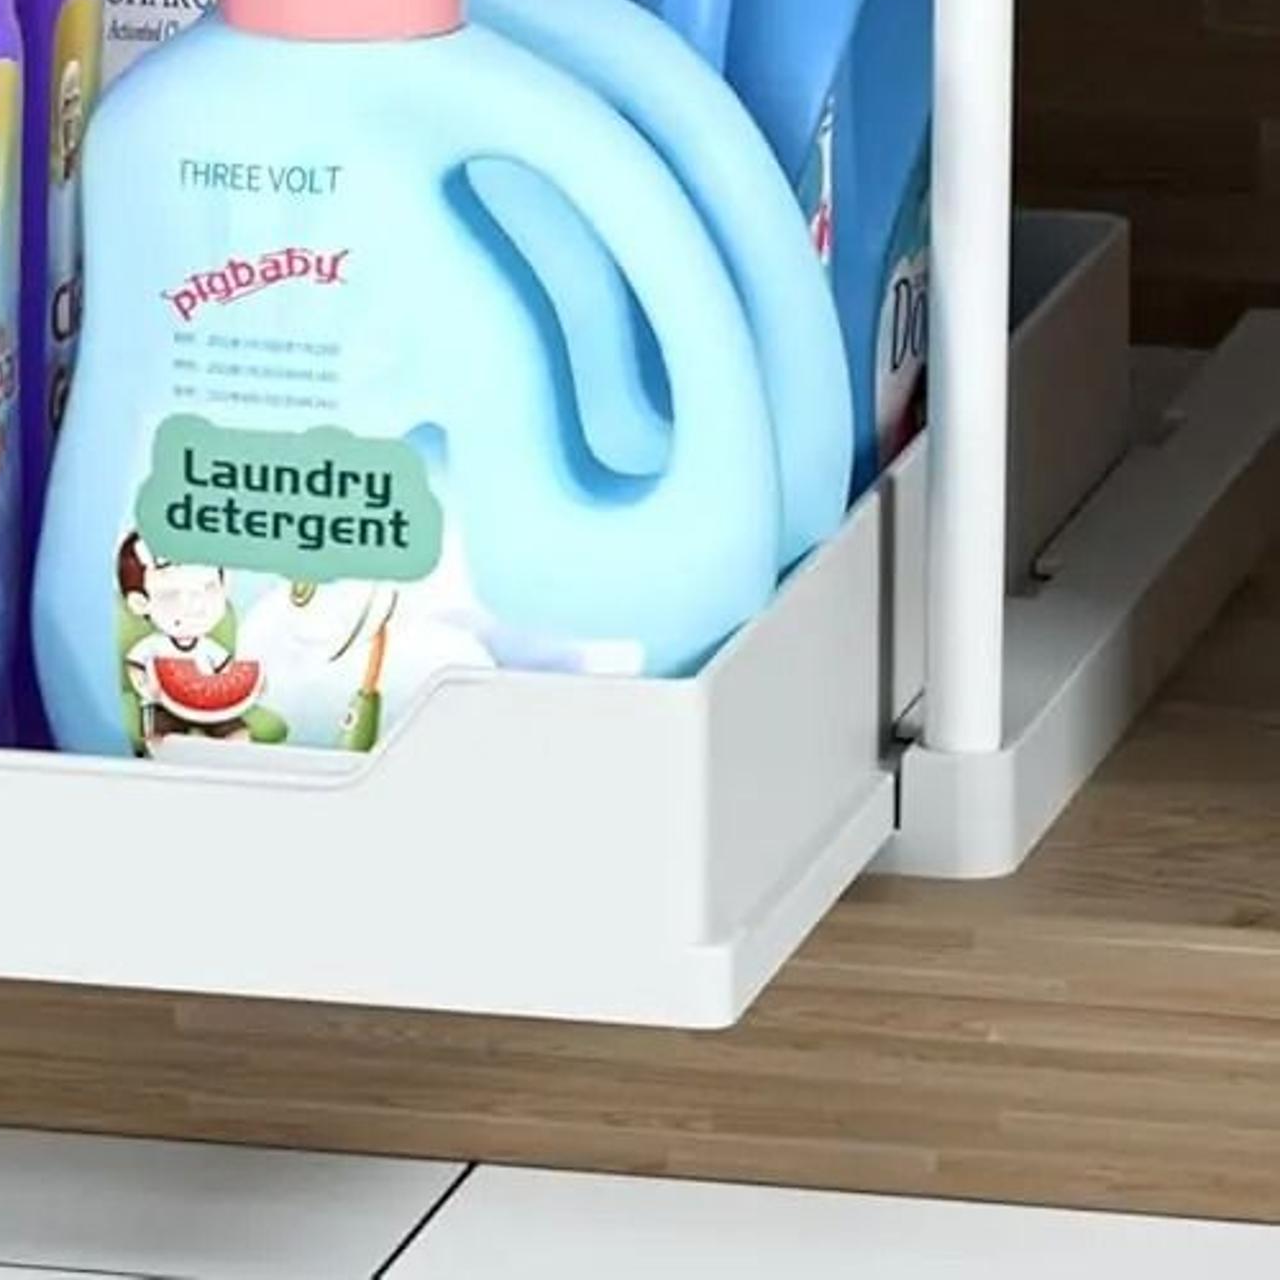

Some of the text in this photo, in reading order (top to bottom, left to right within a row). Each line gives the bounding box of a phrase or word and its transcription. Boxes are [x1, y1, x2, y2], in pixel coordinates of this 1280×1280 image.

[179, 159, 345, 194] THREE VOLT
[171, 246, 351, 323] pigbaby
[183, 447, 393, 509] Laundry
[165, 492, 410, 550] detergent
